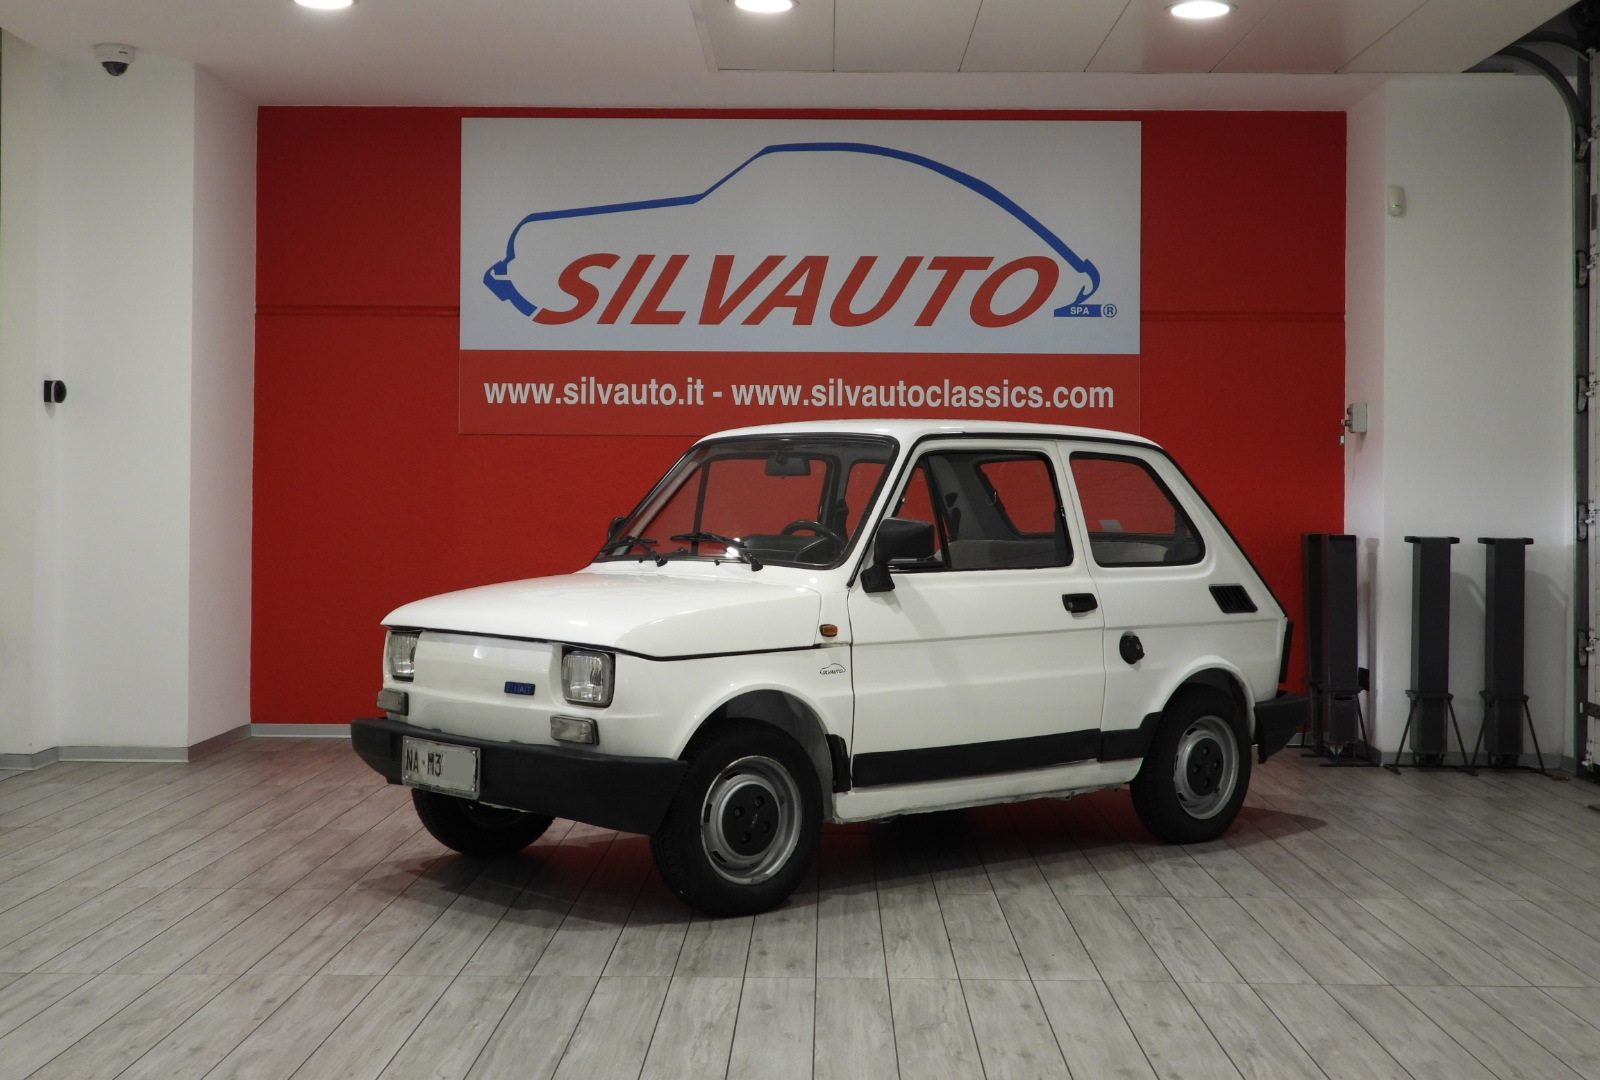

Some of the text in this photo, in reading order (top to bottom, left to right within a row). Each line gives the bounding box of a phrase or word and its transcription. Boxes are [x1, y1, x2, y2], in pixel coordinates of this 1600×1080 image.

[534, 254, 1058, 326] SILVAUTO
[1069, 306, 1090, 315] SPA
[483, 376, 706, 405] www.silvauto.it
[731, 378, 1114, 408] www.silvautoclassics.com
